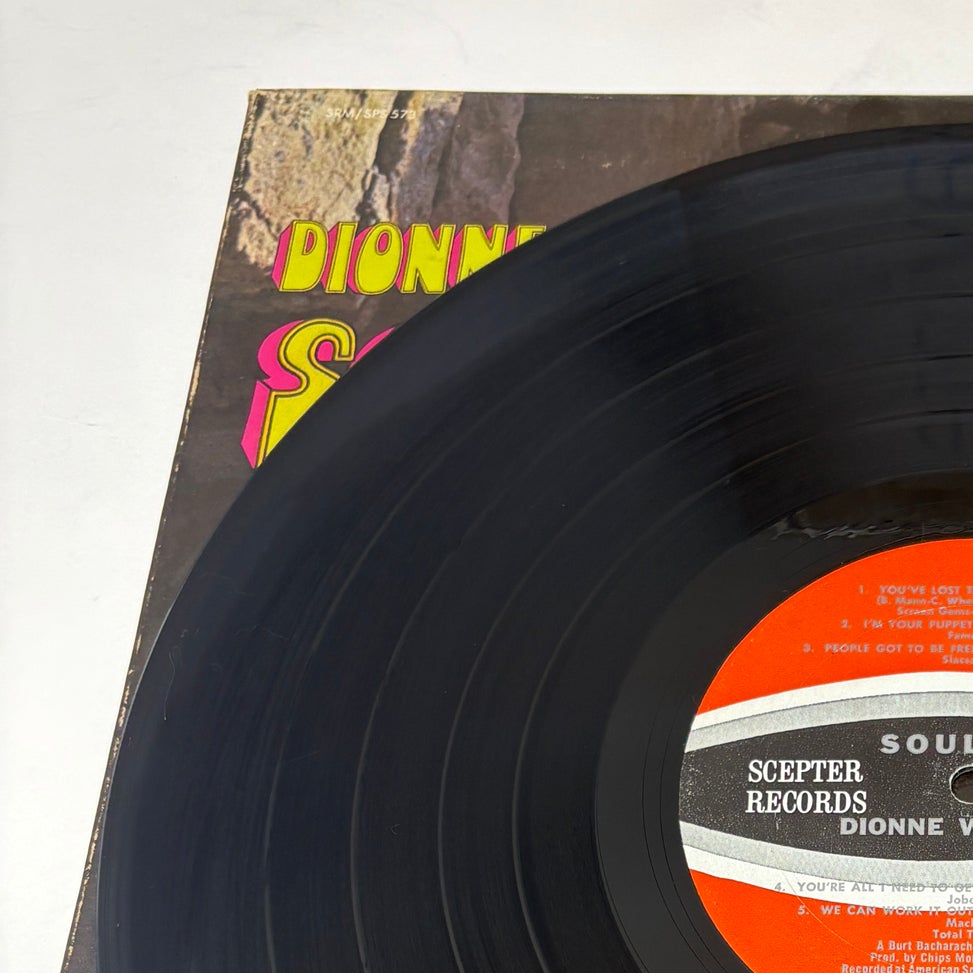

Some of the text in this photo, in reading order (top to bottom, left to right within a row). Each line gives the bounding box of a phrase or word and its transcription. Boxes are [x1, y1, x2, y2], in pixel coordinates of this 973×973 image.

[271, 219, 547, 296] DIONN
[879, 585, 926, 595] YOU'VE
[931, 585, 960, 595] LOST
[863, 619, 883, 629] I'M
[888, 620, 923, 629] YOUR
[929, 620, 973, 629] PUPPET
[824, 643, 870, 653] PEOPLE
[876, 643, 901, 653] GOT
[907, 644, 924, 653] TO
[930, 644, 944, 653] BE
[747, 759, 863, 783] SCEPTER
[745, 790, 867, 815] RECORDS
[839, 817, 944, 836] DIONNE
[774, 882, 785, 892] 4.
[797, 882, 845, 892] YOU'RE
[851, 882, 874, 892] ALL
[891, 882, 927, 893] NEED
[931, 883, 948, 893] TO
[797, 905, 810, 915] 5.
[821, 905, 841, 915] WE
[847, 905, 876, 915] CAN
[882, 905, 923, 916] WORK
[928, 906, 941, 916] IT
[946, 905, 973, 916] OUT
[932, 929, 963, 939] Total
[876, 940, 884, 951] A
[888, 940, 912, 951] Burt
[869, 952, 899, 962] Prod.
[903, 953, 917, 964] by
[920, 952, 951, 963] Chips
